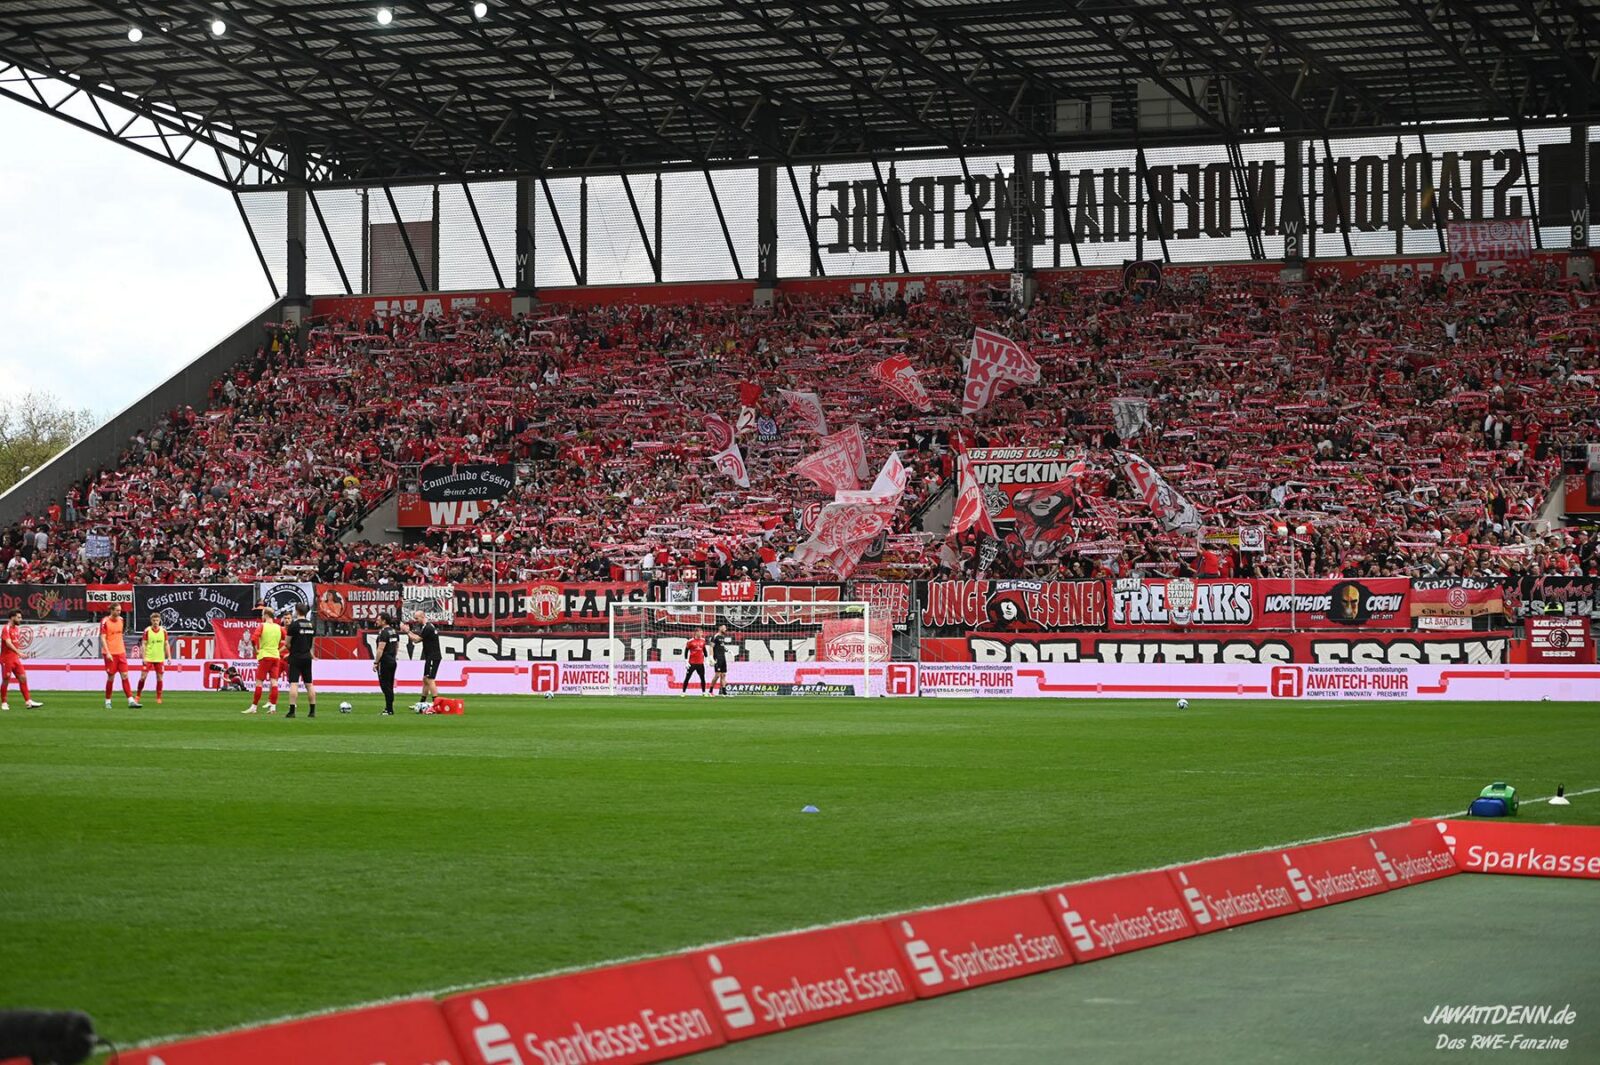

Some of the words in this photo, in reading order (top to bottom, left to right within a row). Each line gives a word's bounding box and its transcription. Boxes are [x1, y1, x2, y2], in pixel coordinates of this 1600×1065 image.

[968, 449, 987, 460] LOS
[1026, 447, 1059, 459] LOCOS
[481, 470, 511, 489] Essen
[973, 461, 1076, 484] WRECKIN
[443, 488, 465, 496] Since
[468, 486, 488, 495] 2012
[721, 582, 751, 596] RVT
[1017, 580, 1042, 590] 2000
[28, 591, 84, 611] Esen
[87, 591, 107, 602] West
[110, 591, 131, 602] Boys
[146, 590, 194, 610] Essener
[198, 587, 240, 612] Löwen
[456, 588, 528, 620] RUDE
[563, 588, 651, 619] FANS
[921, 579, 989, 628] JUNGE
[1027, 579, 1105, 628] ESSENER
[1264, 595, 1333, 612] NORTHSIDE
[1365, 594, 1403, 611] CREW
[1517, 600, 1593, 616] ESEN
[179, 618, 207, 630] 1980
[1314, 638, 1505, 665] ESSEN
[725, 684, 780, 692] GARTENBAU
[919, 672, 1014, 687] AWATECH-RUHR
[1306, 675, 1409, 690] AWATECH-RUHR
[1391, 855, 1433, 884] Sparkasse
[1427, 850, 1457, 872] Essen
[1466, 845, 1600, 872] Sparkasse
[1308, 870, 1359, 904] Sparkasse
[1351, 866, 1384, 889] Essen
[1207, 889, 1262, 926] Sparkasse
[1256, 884, 1293, 909] Essen
[1089, 913, 1154, 953] Sparkasse
[1147, 907, 1188, 934] Essen
[939, 941, 1025, 985] Sparkasse
[1015, 933, 1065, 962] Essen
[752, 976, 854, 1028] Sparkasse
[845, 966, 906, 1000] Essen
[523, 1021, 651, 1065] Sparkasse
[640, 1007, 713, 1047] Essen
